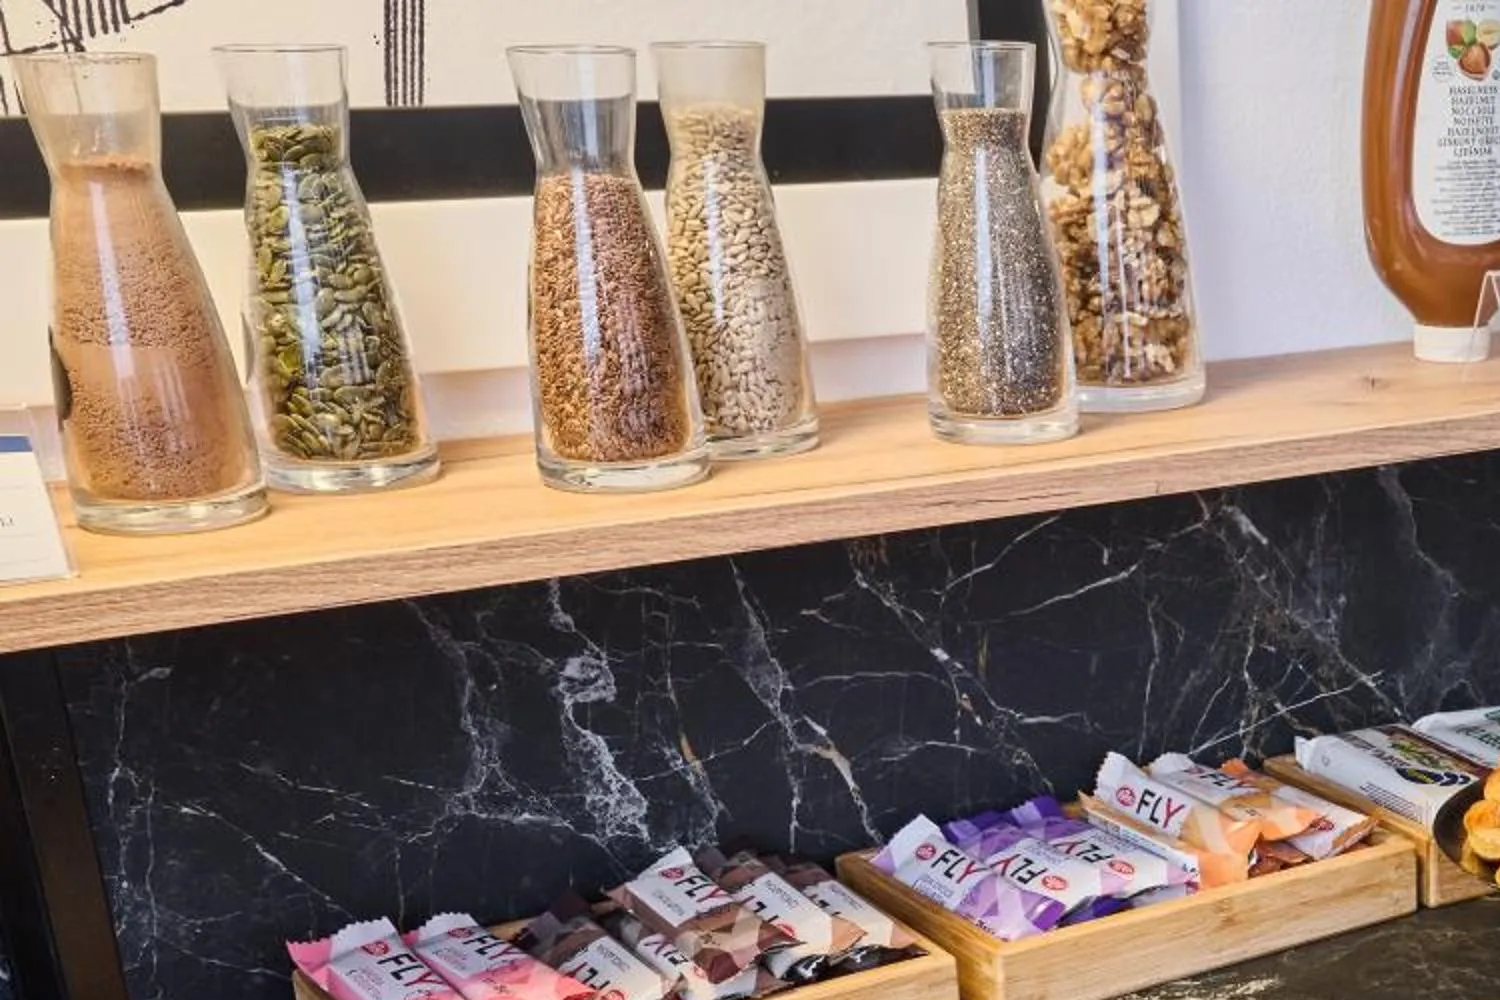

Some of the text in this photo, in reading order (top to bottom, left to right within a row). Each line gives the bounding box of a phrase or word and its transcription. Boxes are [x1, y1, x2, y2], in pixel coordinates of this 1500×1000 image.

[1200, 773, 1256, 790] FLY
[1135, 789, 1185, 828] FLY
[1053, 840, 1114, 863] FLY
[931, 850, 988, 884] FLY
[989, 854, 1048, 884] FLY
[674, 875, 731, 902] FLY
[463, 932, 527, 961] FLY
[377, 953, 447, 987] FLY
